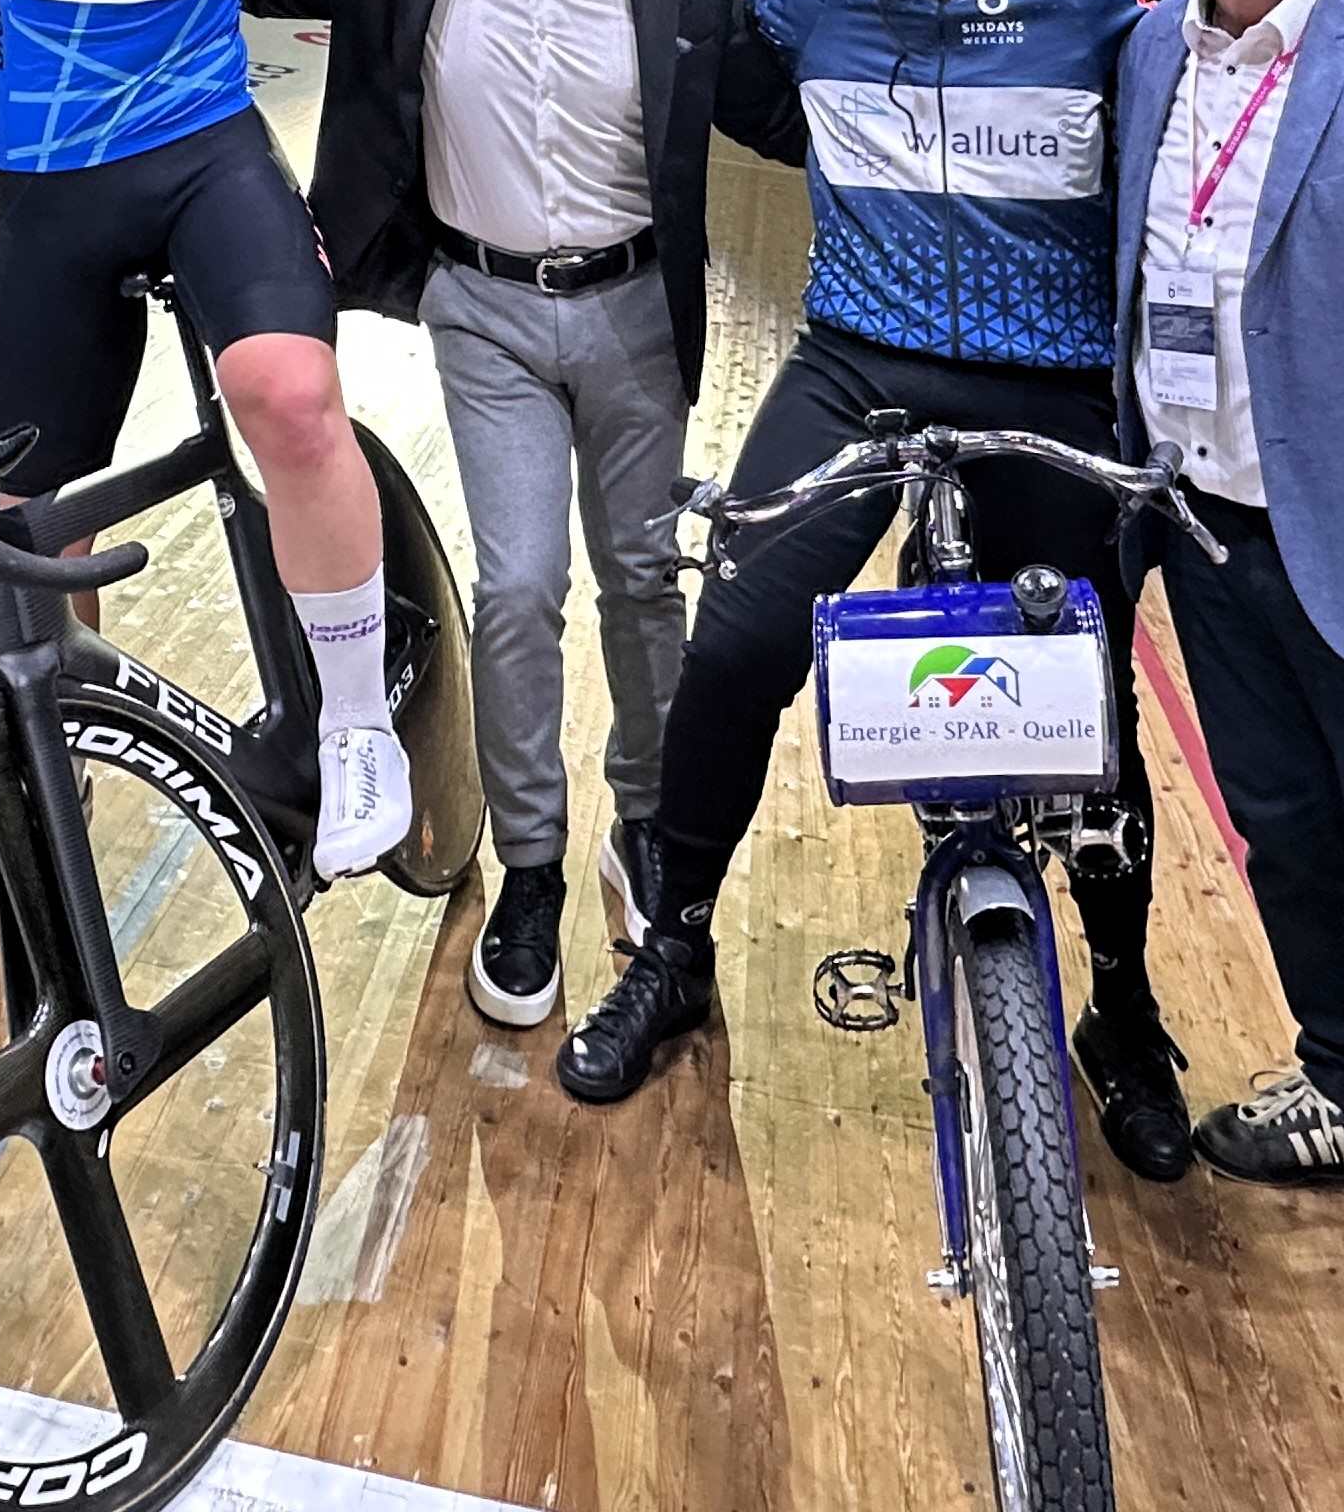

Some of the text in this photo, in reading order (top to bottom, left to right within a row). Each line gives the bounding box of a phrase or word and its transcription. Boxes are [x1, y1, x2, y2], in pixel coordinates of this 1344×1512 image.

[961, 20, 1025, 35] SIXDAYS
[962, 34, 1024, 45] WEEKEND
[116, 651, 232, 757] FES
[838, 722, 921, 745] Energie
[944, 720, 999, 741] SPAR
[1023, 718, 1096, 743] Quelle
